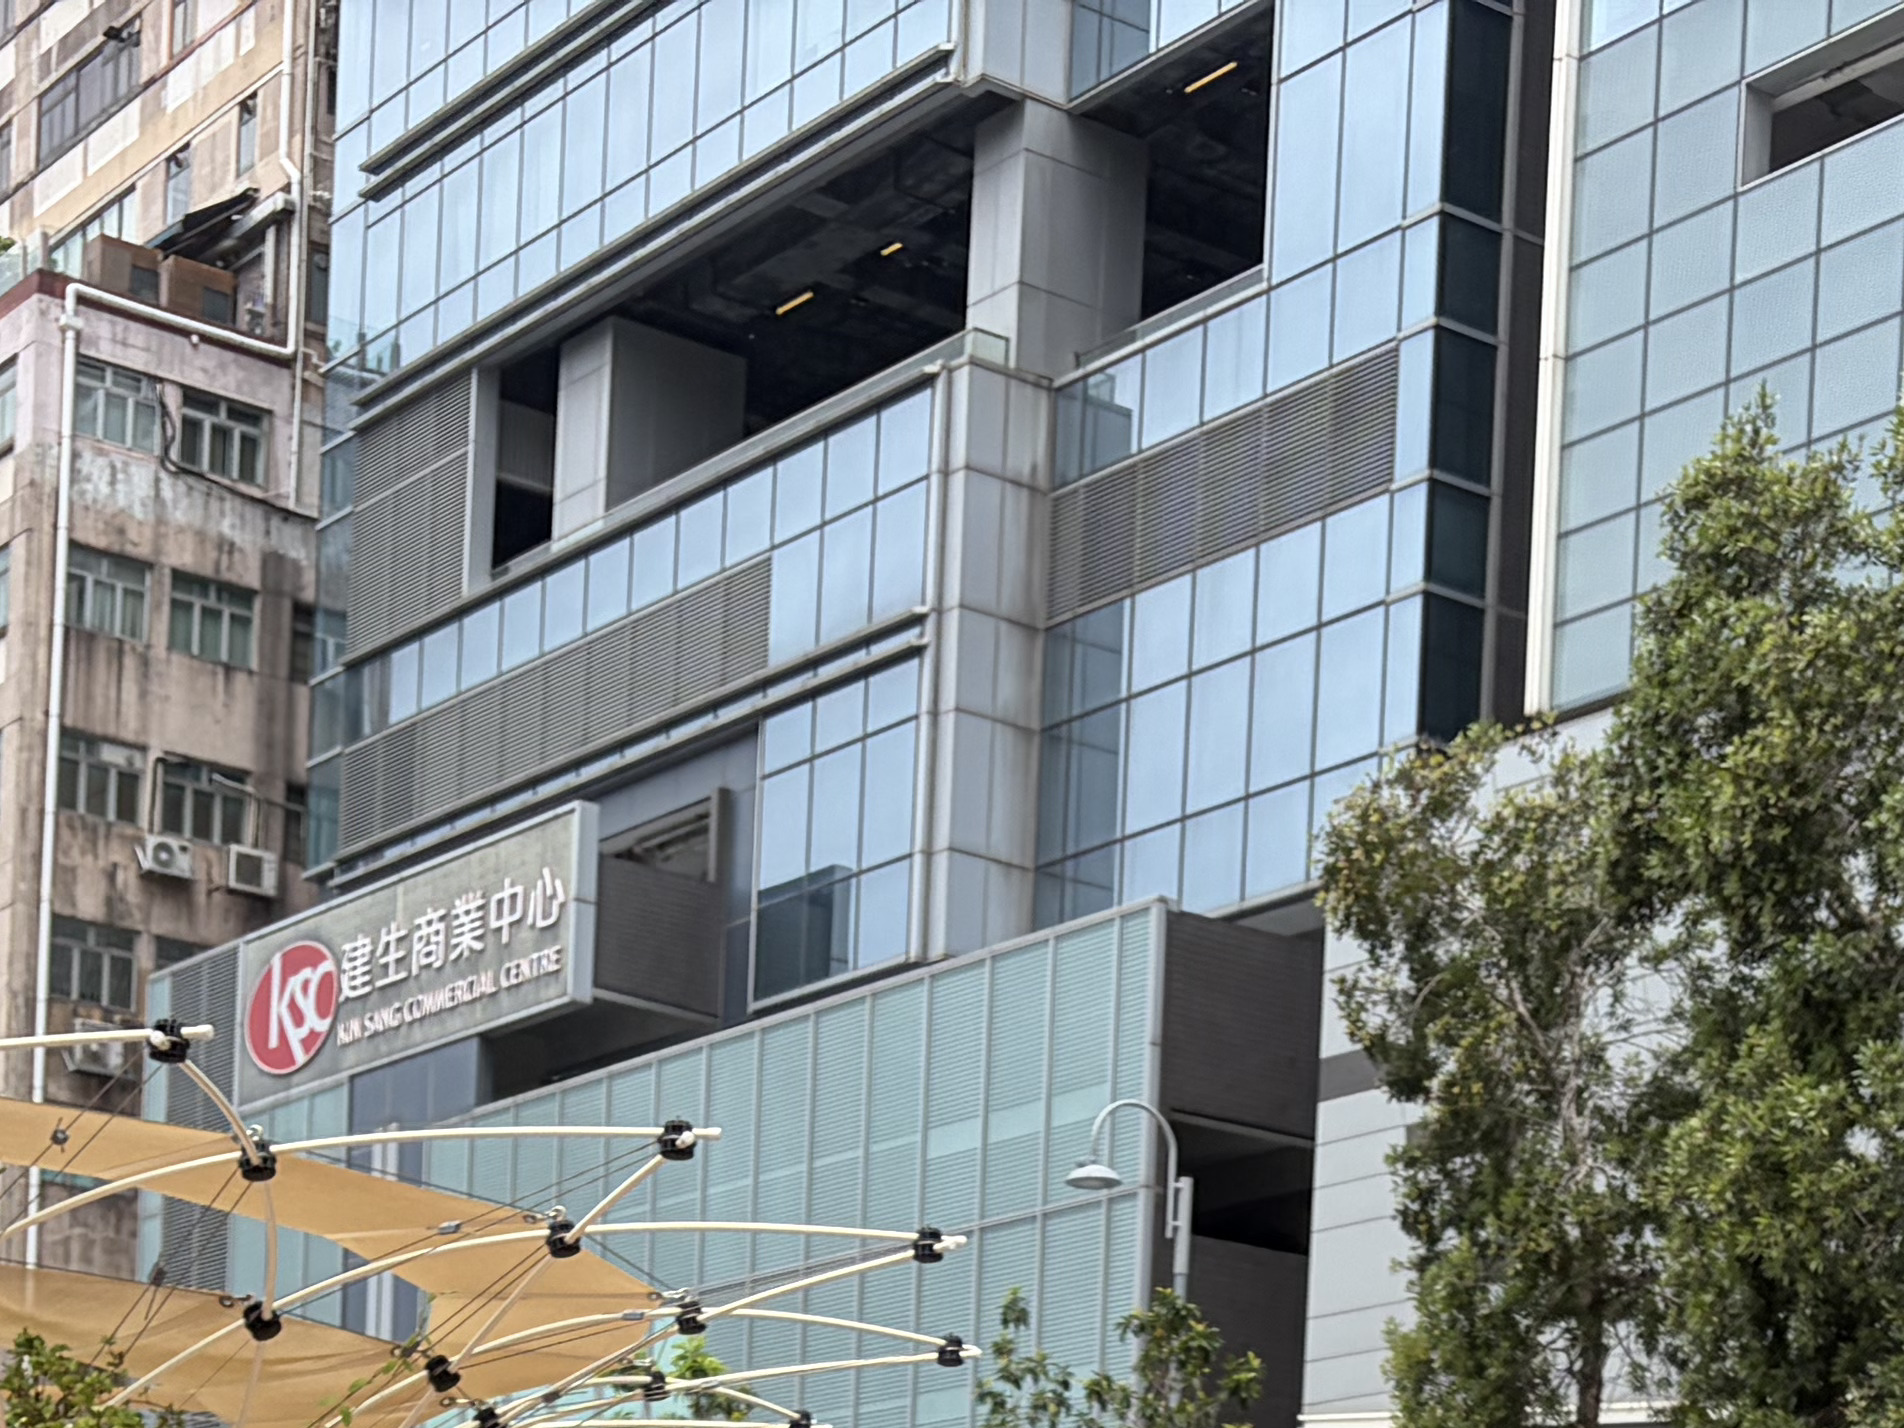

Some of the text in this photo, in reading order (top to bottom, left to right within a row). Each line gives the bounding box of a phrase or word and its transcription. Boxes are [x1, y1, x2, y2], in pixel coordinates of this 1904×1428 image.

[339, 867, 566, 1003] 建生商業中心
[364, 1001, 403, 1038] SANG
[403, 969, 499, 1023] COMMERCIAL
[500, 944, 563, 989] CENTRE
